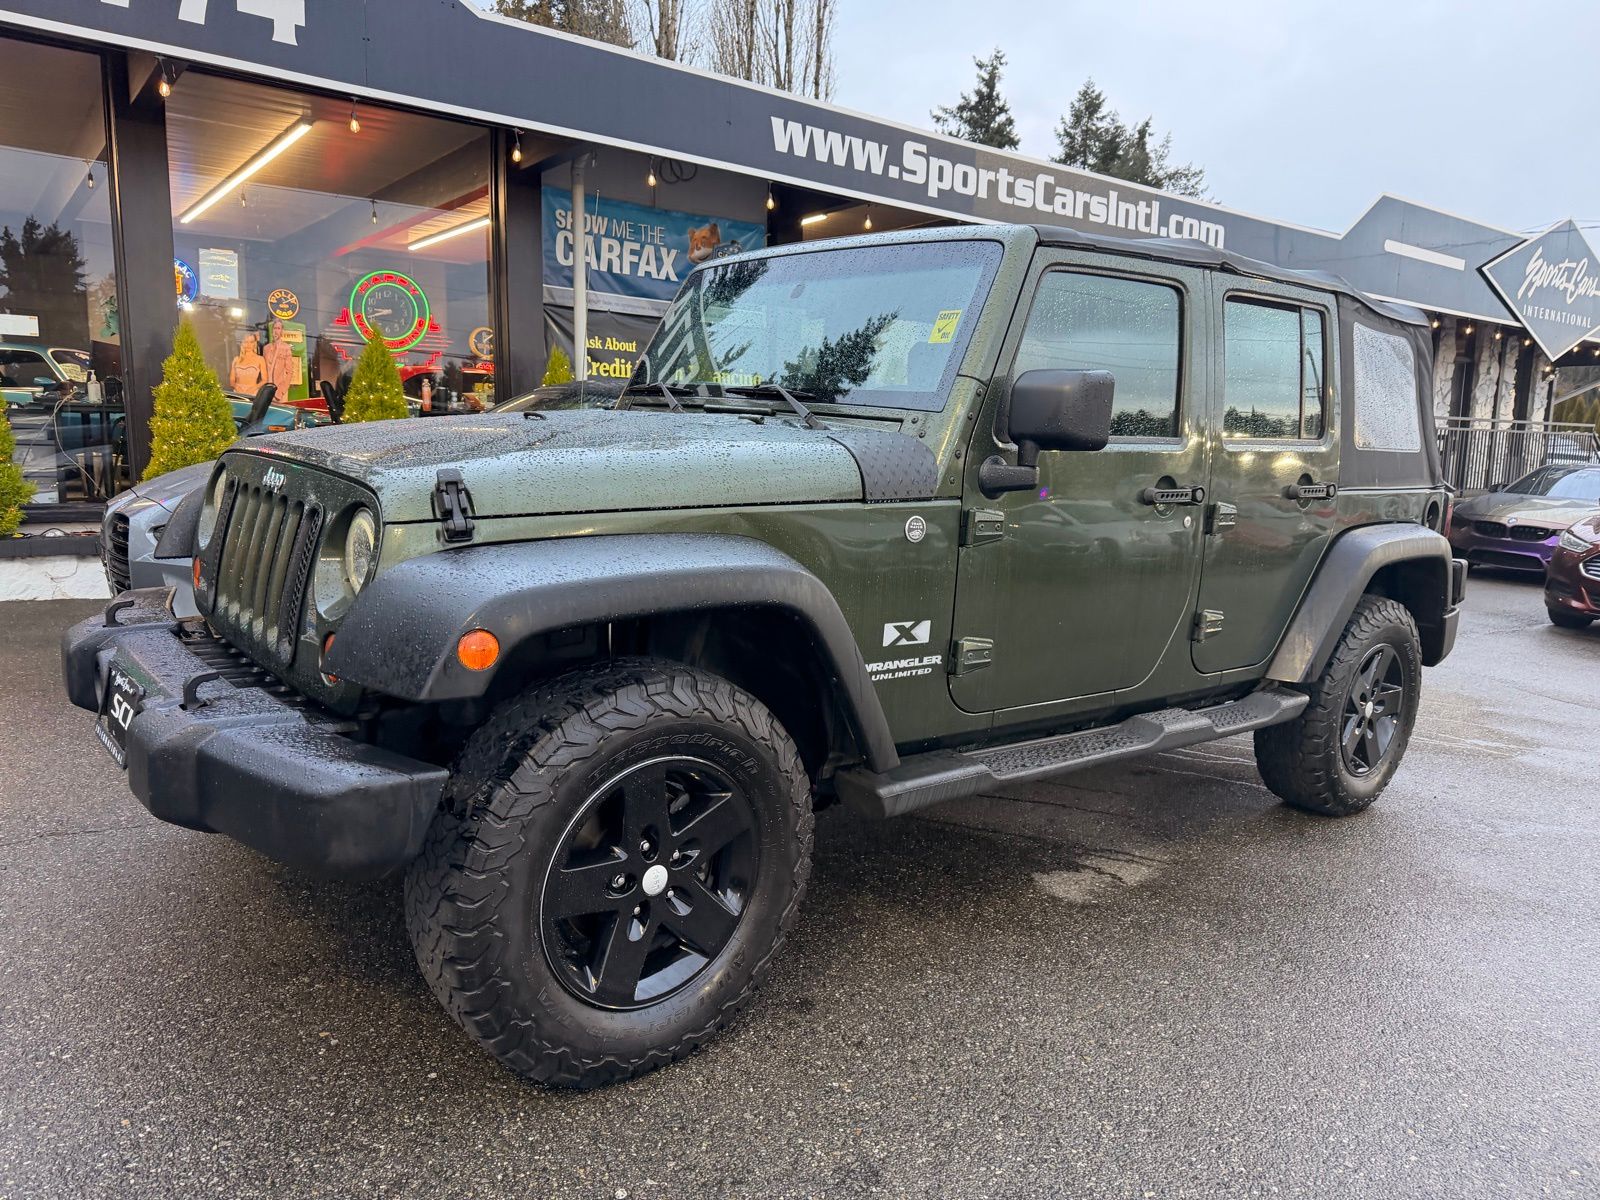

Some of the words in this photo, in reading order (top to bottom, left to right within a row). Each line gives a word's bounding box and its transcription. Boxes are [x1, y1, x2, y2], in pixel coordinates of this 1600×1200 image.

[770, 116, 1225, 249] www.SportsCarsIntl.com
[612, 219, 635, 240] ME
[638, 223, 665, 246] THE
[555, 230, 679, 282] CARFAX
[1523, 304, 1592, 329] INTERNATIONAL
[604, 337, 637, 353] About
[262, 466, 286, 494] Jeep
[871, 668, 932, 681] UNLIMITED
